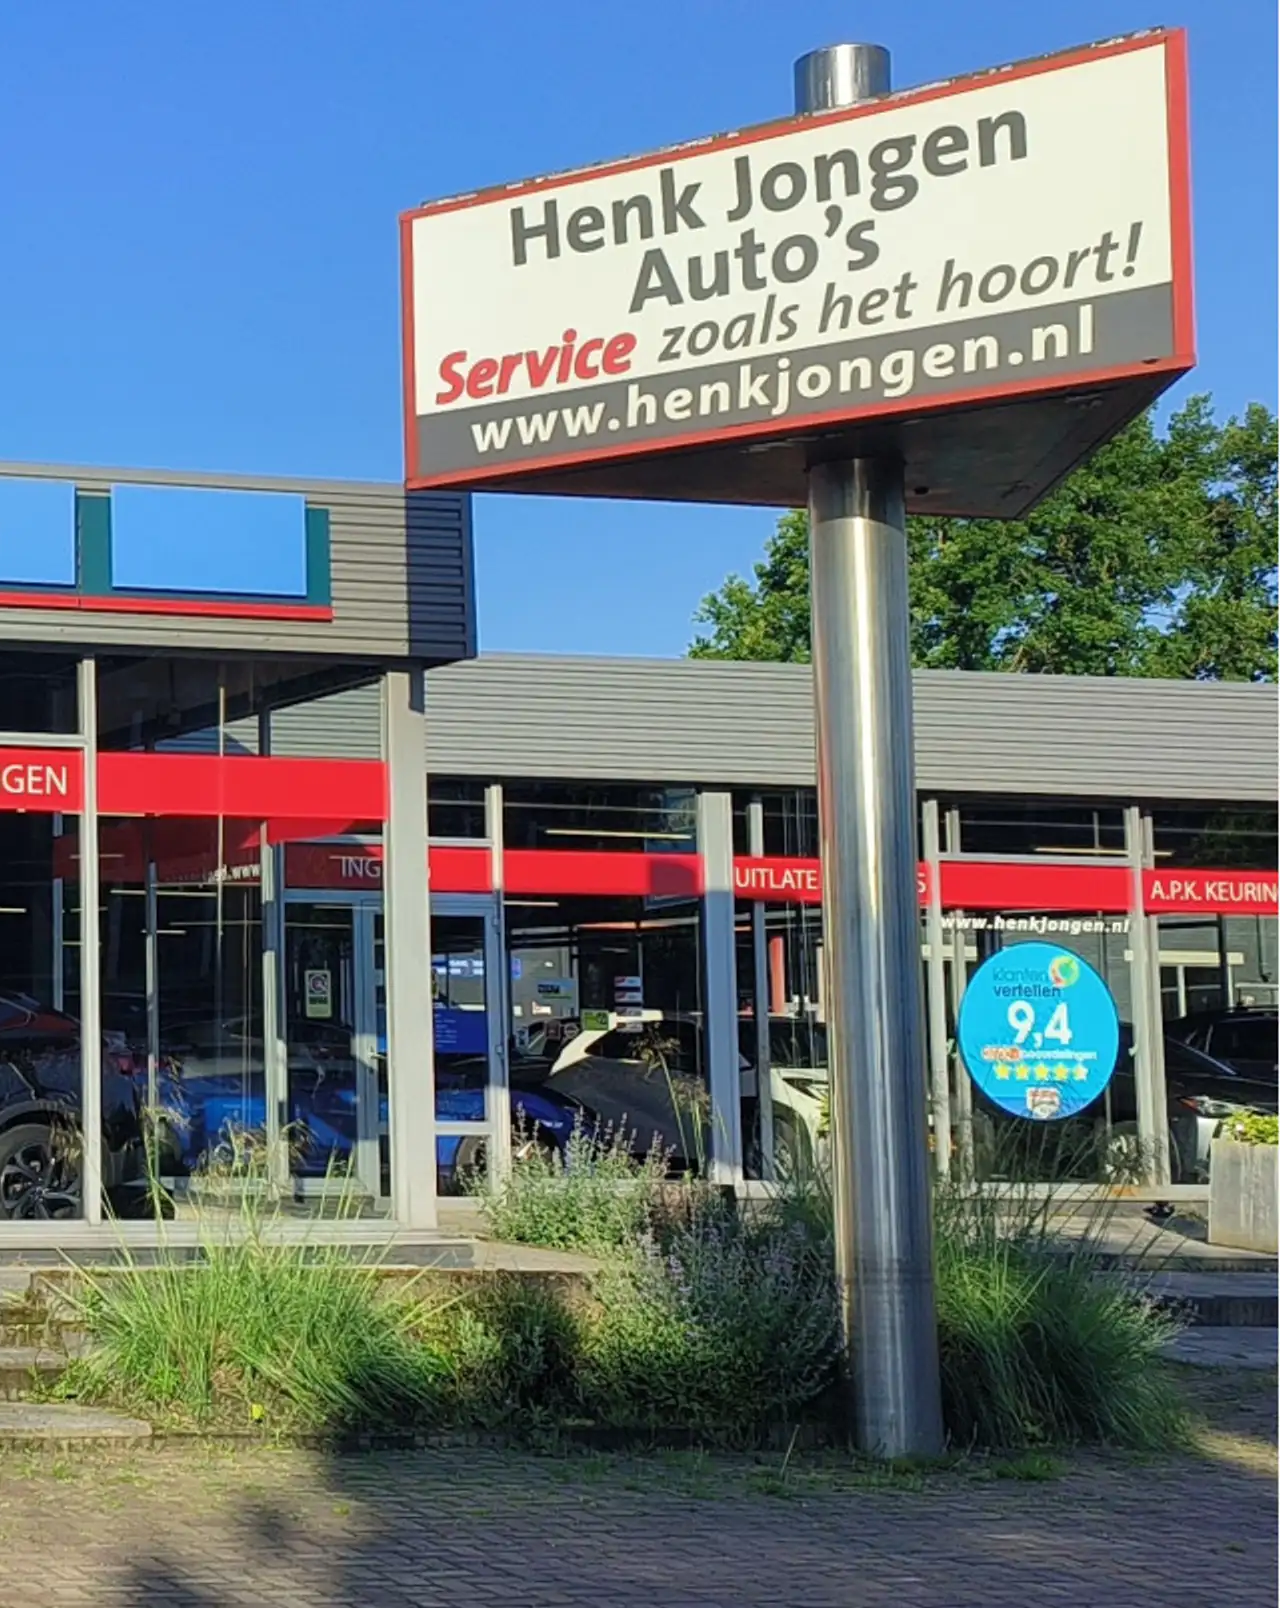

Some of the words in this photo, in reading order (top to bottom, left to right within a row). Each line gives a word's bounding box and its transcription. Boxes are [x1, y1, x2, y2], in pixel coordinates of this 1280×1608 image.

[510, 168, 702, 268] Henk
[726, 108, 1028, 222] Jongen
[628, 204, 881, 313] Auto's
[434, 327, 637, 405] Service
[656, 294, 798, 364] zoals
[818, 279, 914, 334] het
[935, 221, 1143, 315] hoort!
[471, 303, 1095, 454] www.henkjongen.nl
[735, 867, 818, 890] UITLATE
[1150, 881, 1201, 901] A.P.K.
[941, 915, 1131, 934] www.henkjongen.nl
[1007, 1000, 1073, 1048] 9,4
